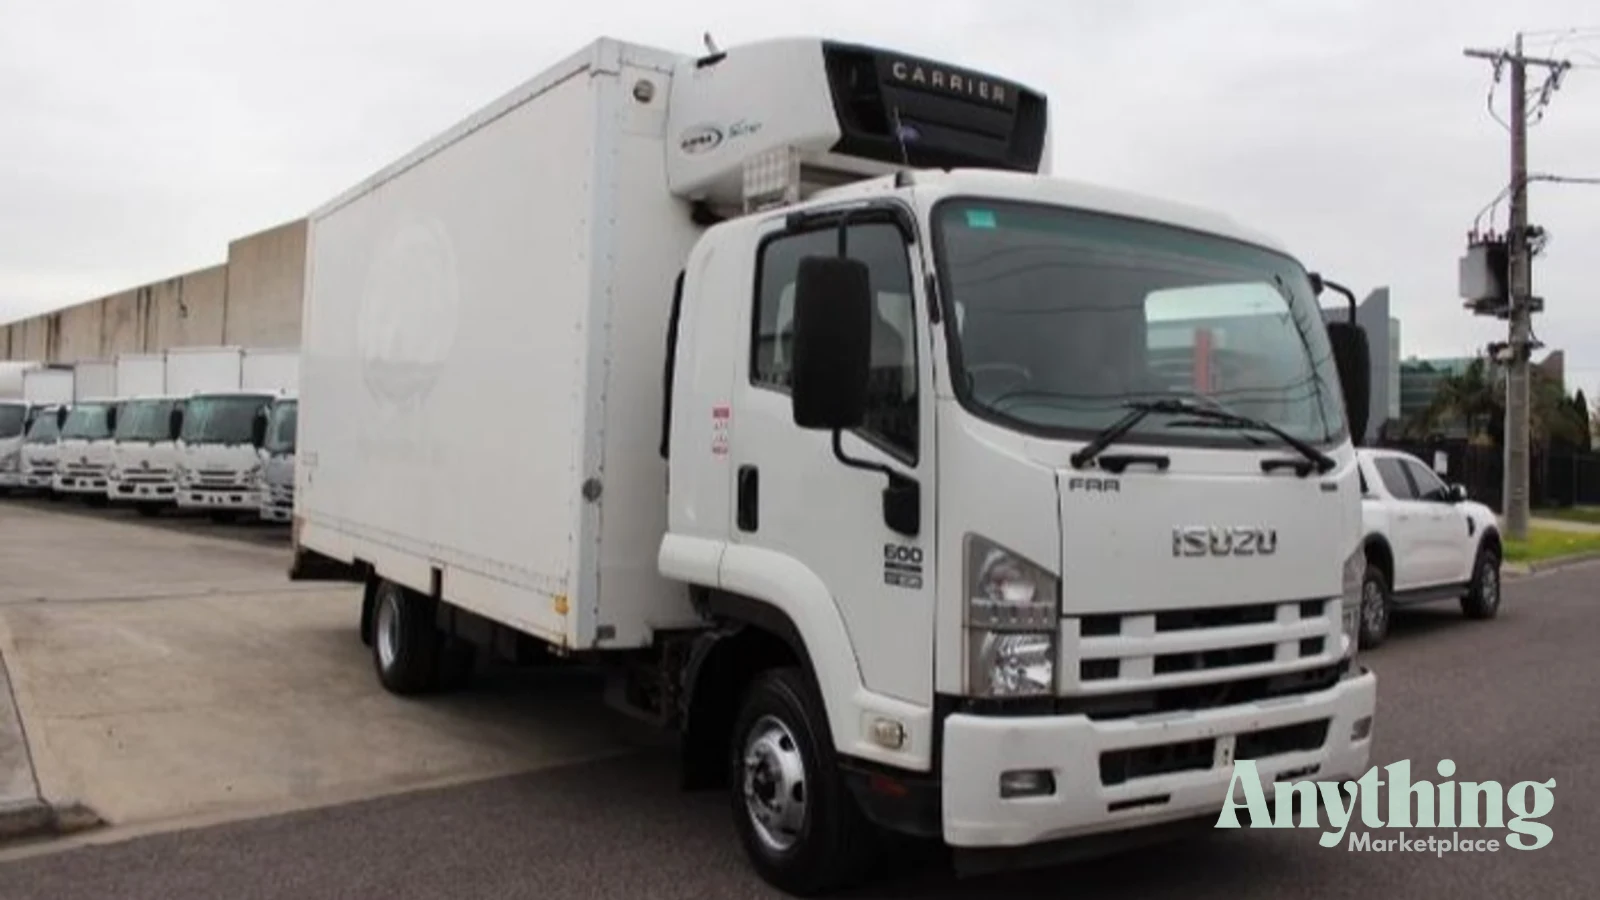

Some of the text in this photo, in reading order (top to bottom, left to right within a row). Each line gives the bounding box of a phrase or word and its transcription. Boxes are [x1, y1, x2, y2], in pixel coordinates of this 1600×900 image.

[892, 61, 1005, 104] CARRIER
[884, 543, 923, 563] 600
[1172, 526, 1277, 557] ISUZU
